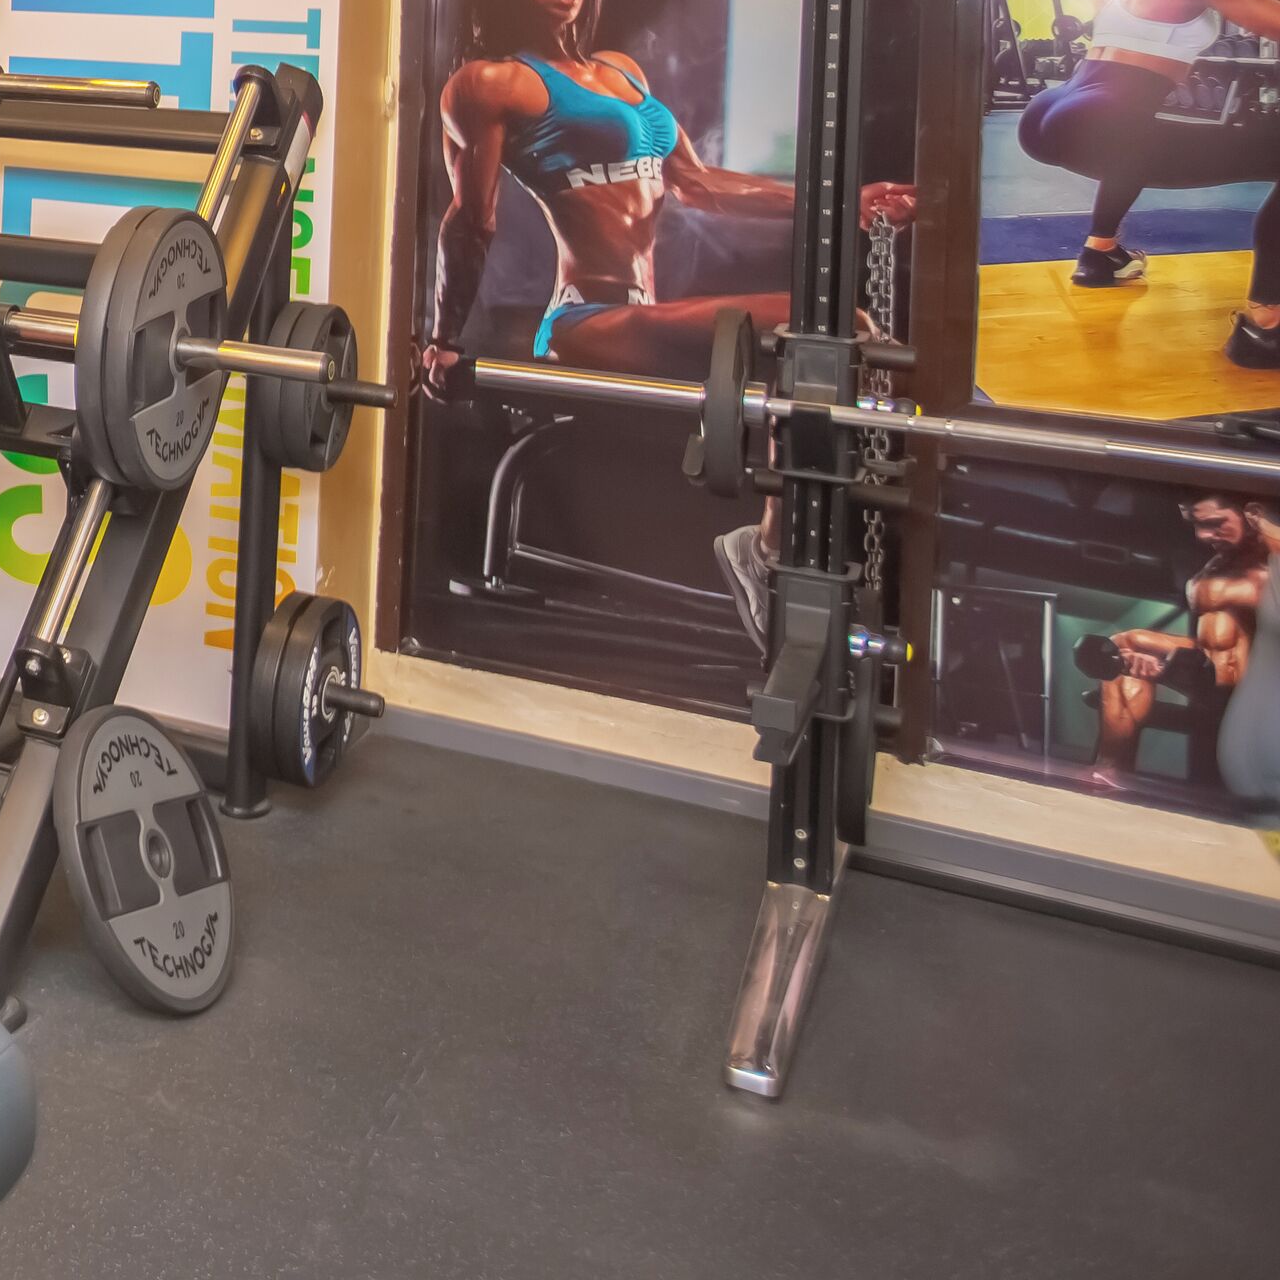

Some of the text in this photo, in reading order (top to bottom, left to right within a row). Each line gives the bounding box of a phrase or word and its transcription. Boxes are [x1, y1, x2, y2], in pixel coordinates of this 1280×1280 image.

[148, 238, 211, 299] TECHNOGYM
[176, 272, 185, 290] 20
[146, 398, 210, 462] TECHNOGYM
[175, 409, 185, 426] 20
[93, 734, 178, 795] TECHNOGYM
[129, 770, 143, 788] 20
[133, 911, 219, 978] TECHNOGYM
[172, 920, 186, 940] 20
